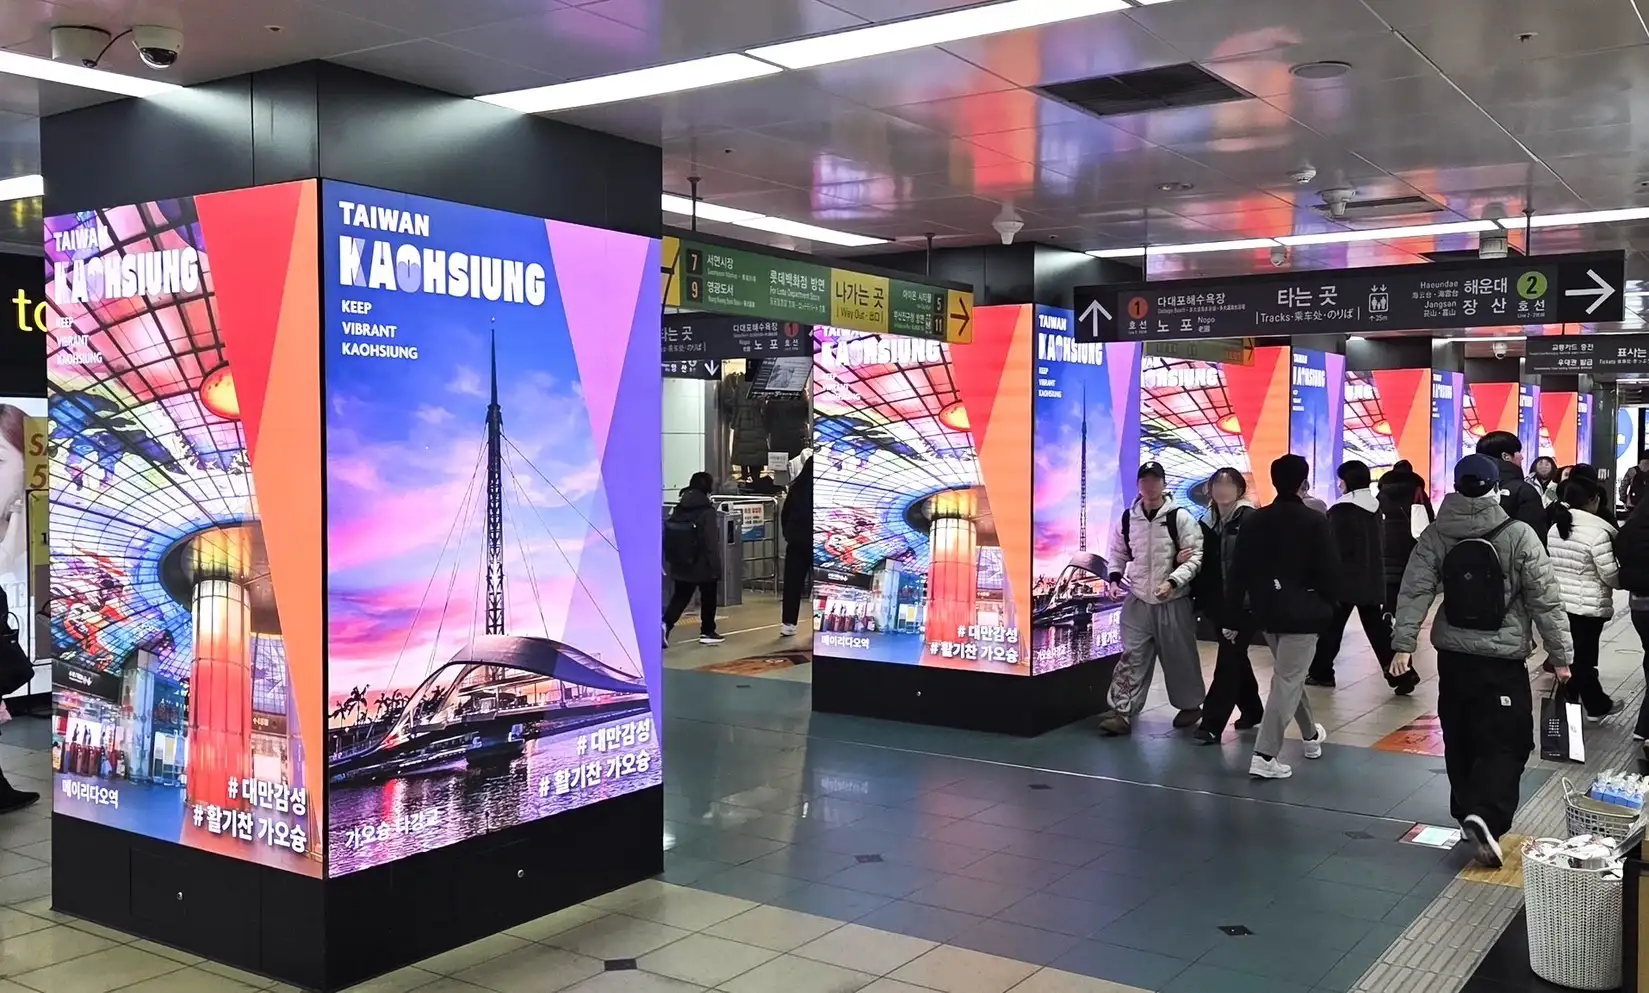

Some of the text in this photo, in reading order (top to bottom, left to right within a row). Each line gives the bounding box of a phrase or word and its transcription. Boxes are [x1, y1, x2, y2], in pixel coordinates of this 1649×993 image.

[338, 200, 430, 237] TAIWAN
[54, 226, 109, 252] TAIWAN
[339, 235, 546, 306] KAOHSIUNG
[691, 254, 698, 270] 7
[707, 254, 734, 270] 서면시장
[54, 247, 199, 304] KAOHSIUNG
[769, 270, 808, 289] 롯데백화점
[811, 277, 825, 292] 방면
[1420, 280, 1459, 289] Haeundae
[691, 281, 698, 298] 9
[707, 281, 734, 297] 영광도서
[1463, 277, 1508, 295] 해운대
[1526, 276, 1538, 294] 2
[835, 281, 870, 306] 나가는
[873, 287, 885, 309] 곳
[936, 297, 942, 311] 5
[1157, 292, 1226, 307] 다대포해수욕장
[1277, 285, 1338, 308] 타는 곳
[341, 300, 372, 315] KEEP
[841, 308, 853, 320] Way
[855, 309, 864, 320] Out
[1134, 301, 1140, 315] 1
[1424, 300, 1457, 310] Jangsan
[341, 321, 397, 339] VIBRANT
[733, 322, 778, 332] 다대포해수욕장
[935, 319, 942, 331] 11
[1038, 314, 1067, 331] TAIWAN
[681, 326, 693, 341] 곳
[341, 342, 418, 359] KAOHSIUNG
[969, 625, 1018, 644] 대만감성
[941, 642, 977, 660] 활기찬
[591, 718, 651, 752] 대만감성
[554, 760, 603, 795] 활기찬
[606, 748, 651, 778] 가오슝
[62, 778, 119, 808] 메이리다오역
[242, 778, 306, 816] 대만감성
[206, 804, 254, 841] 활기찬
[258, 818, 307, 853] 가오슝
